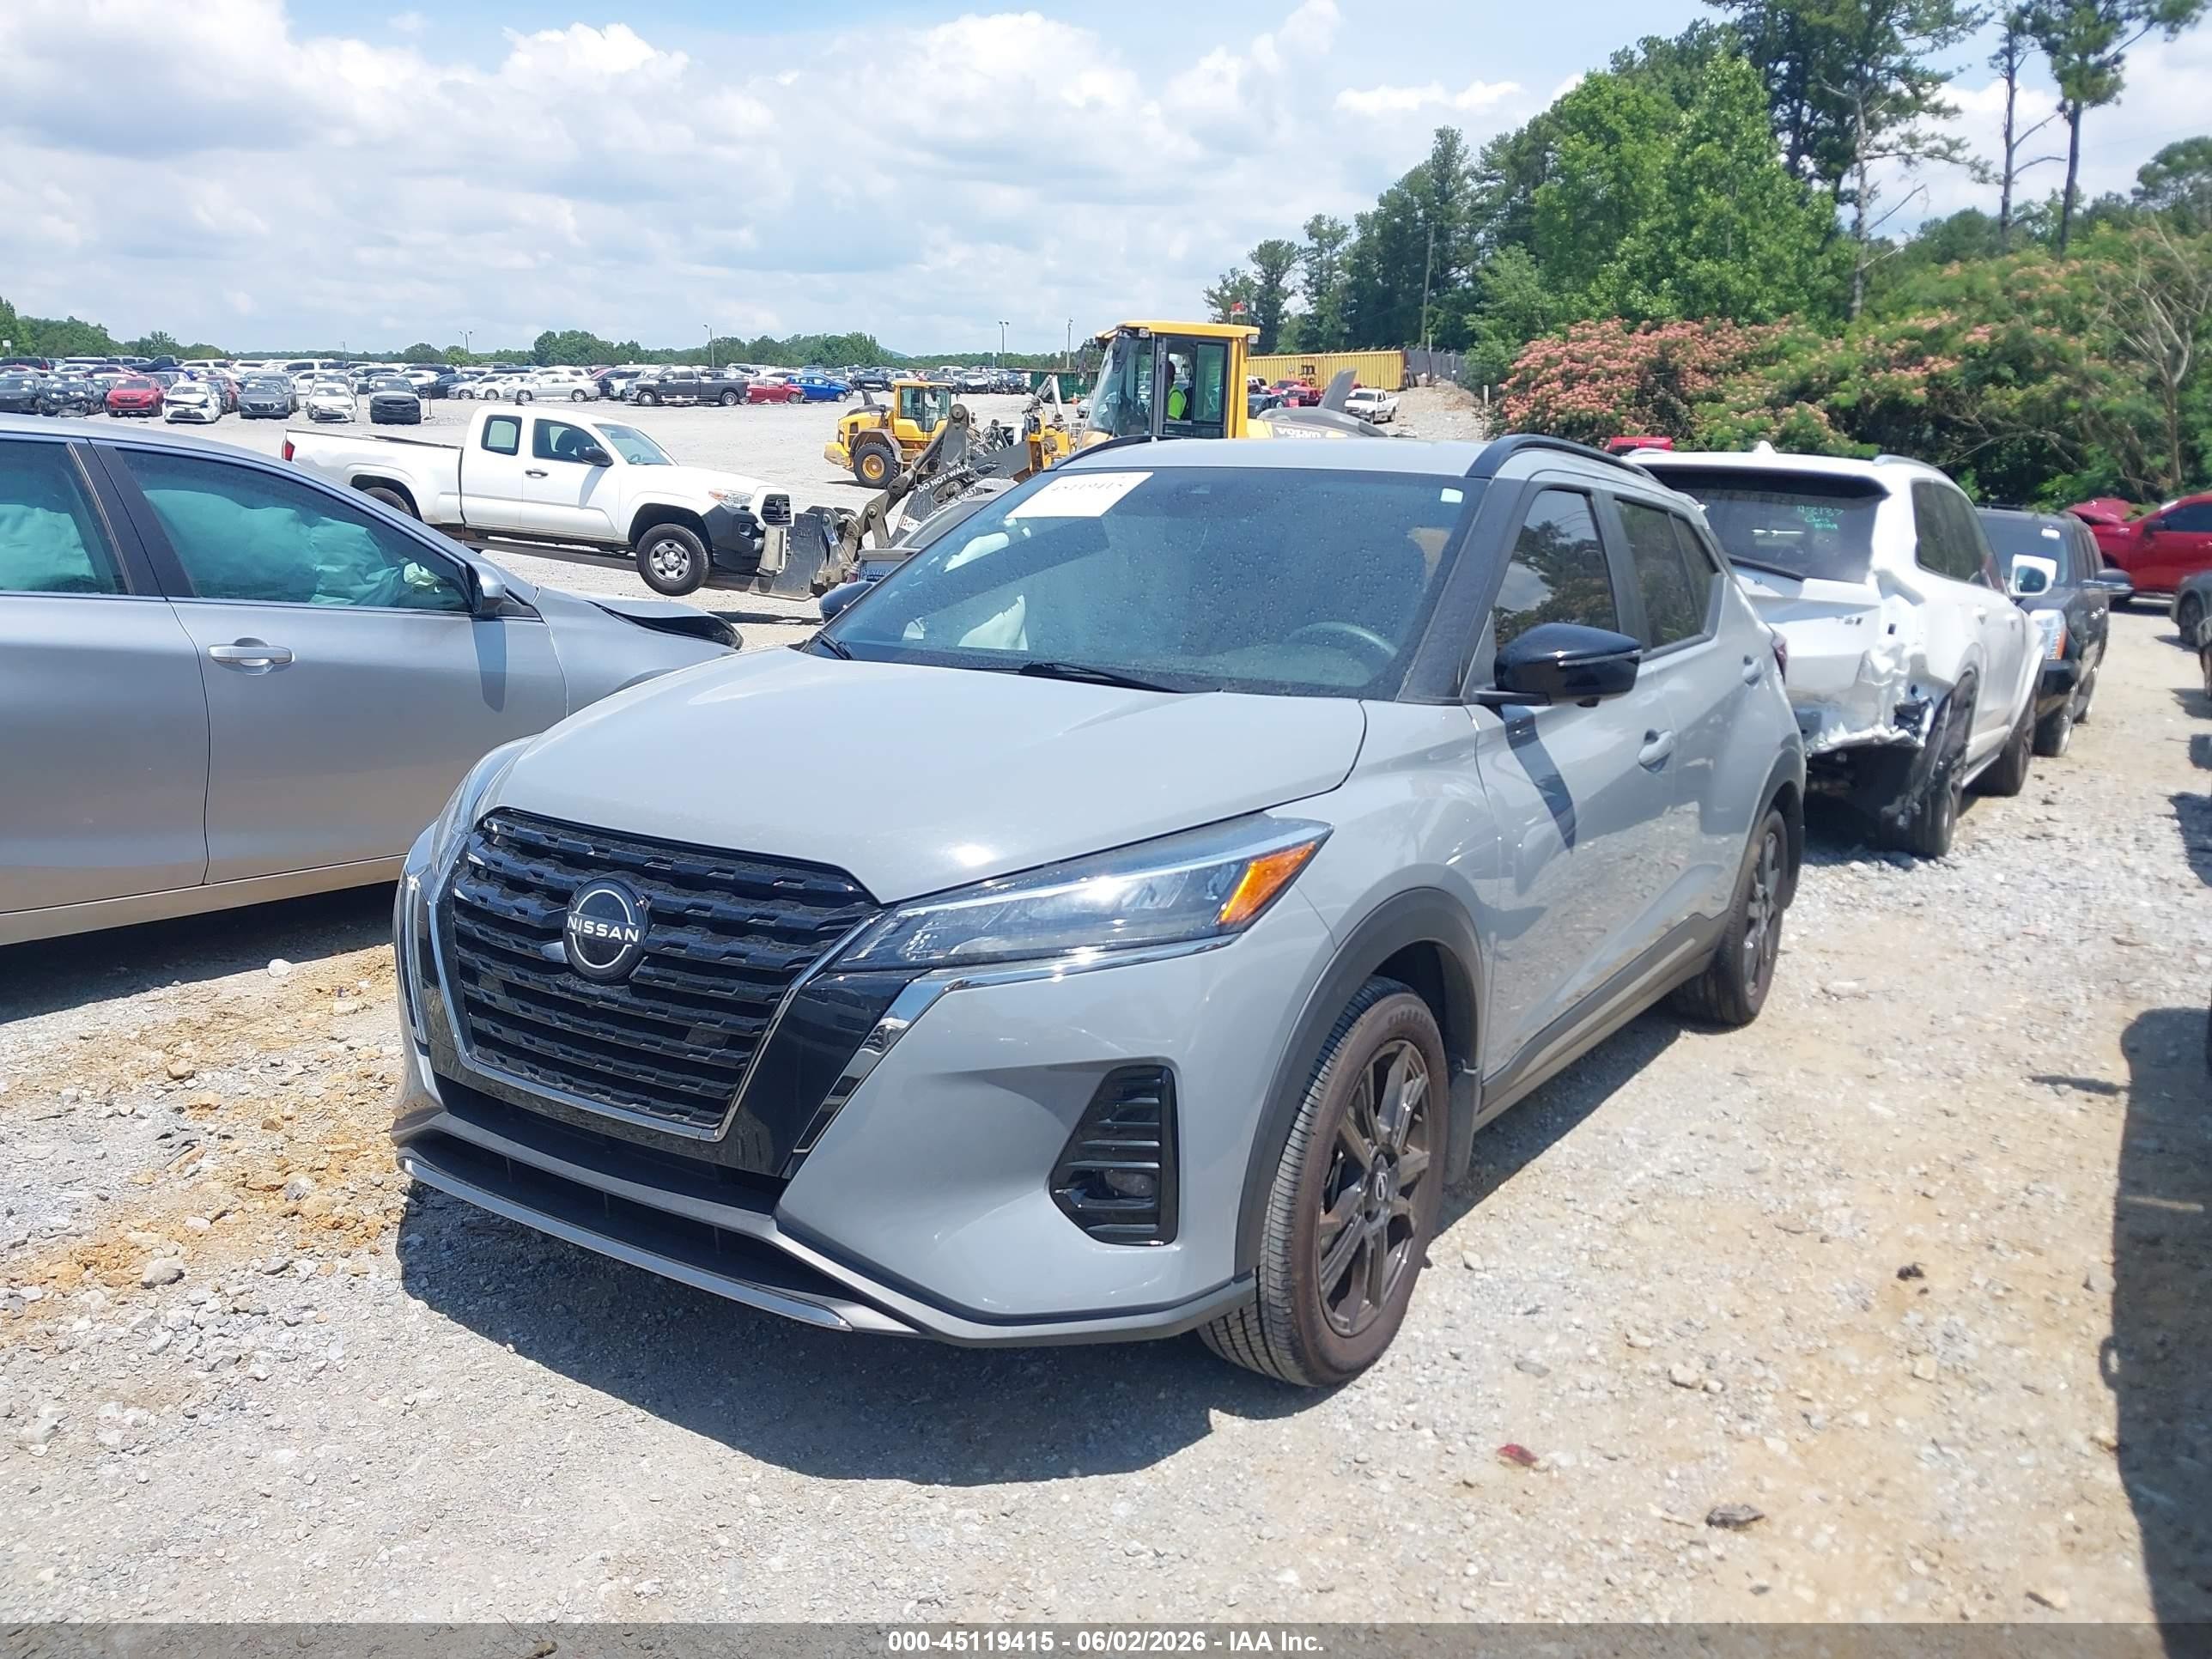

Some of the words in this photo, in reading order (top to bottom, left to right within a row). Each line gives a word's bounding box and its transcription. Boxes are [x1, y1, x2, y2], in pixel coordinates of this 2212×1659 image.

[917, 483, 930, 493] DO
[930, 474, 947, 487] NOT
[947, 465, 971, 478] WALK
[567, 915, 640, 943] NISSAN
